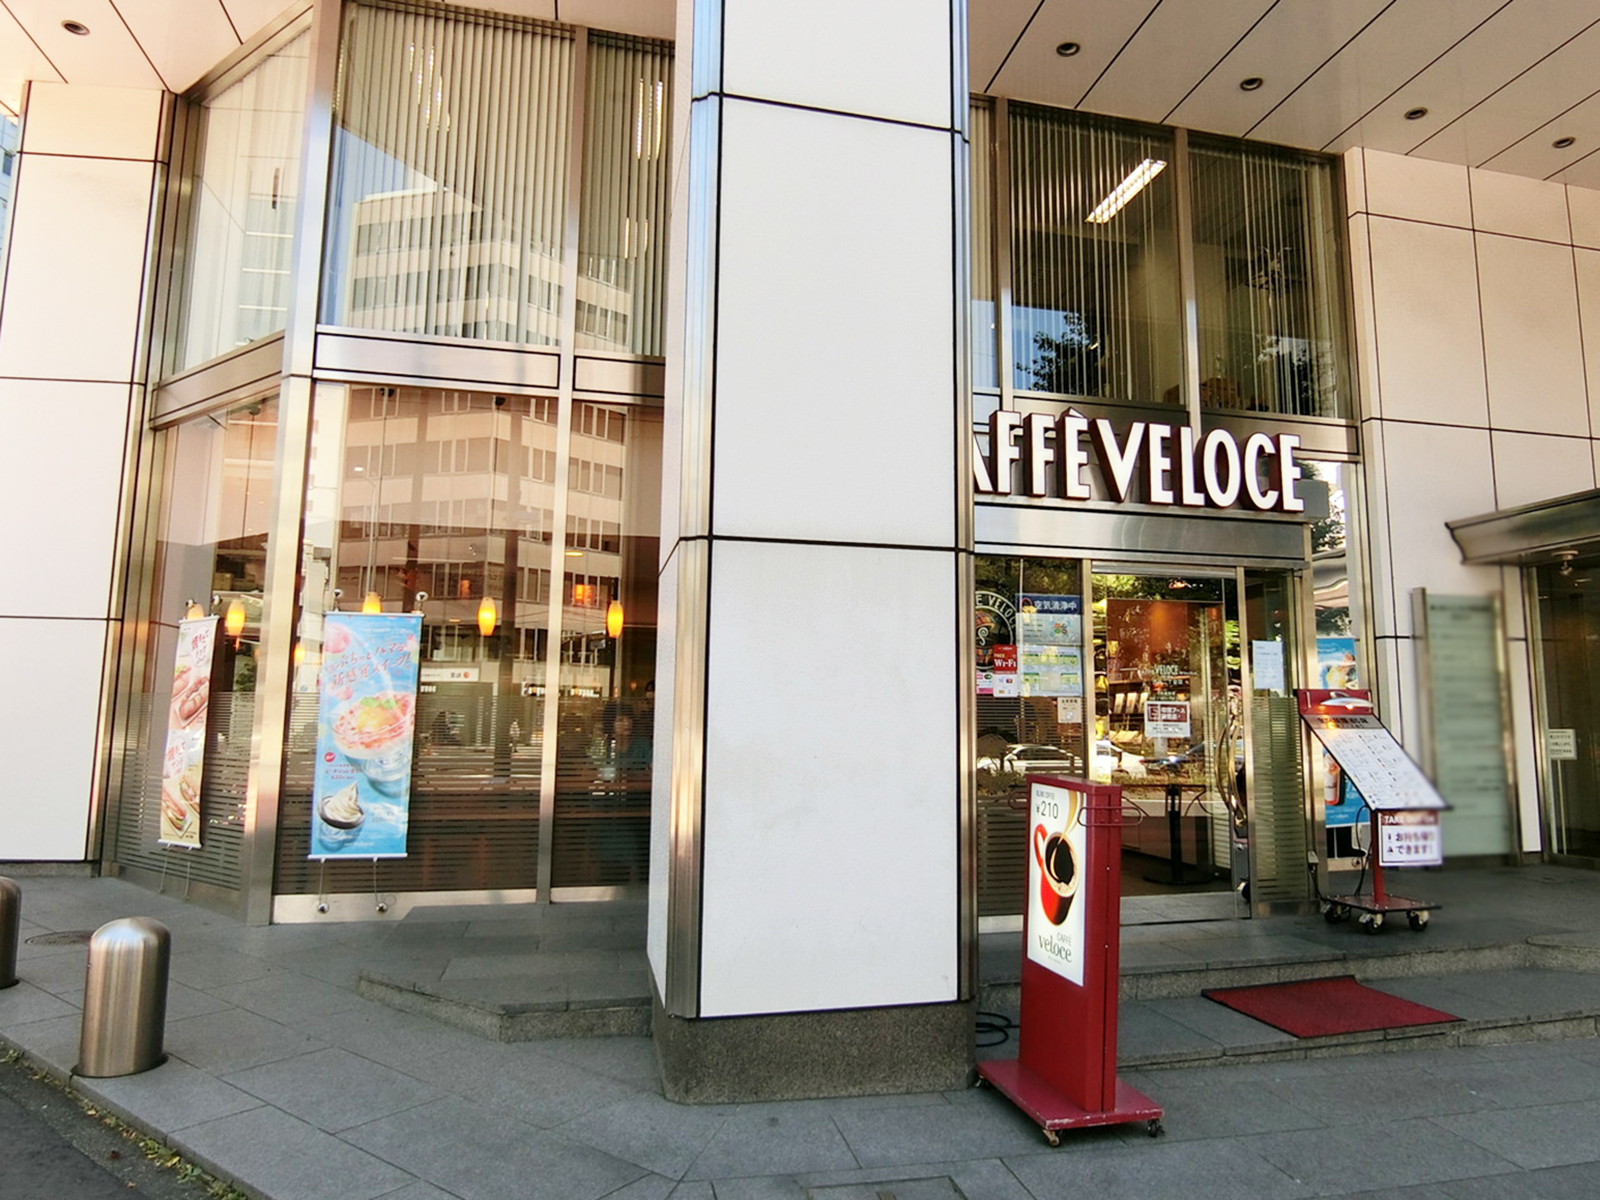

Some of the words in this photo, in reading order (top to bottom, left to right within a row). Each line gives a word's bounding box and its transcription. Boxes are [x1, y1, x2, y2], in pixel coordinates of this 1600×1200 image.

[1091, 418, 1304, 512] VELOCE
[1033, 600, 1077, 611] 空気清浄中
[994, 659, 1017, 668] Wi-Fi
[1036, 800, 1059, 819] ¥210
